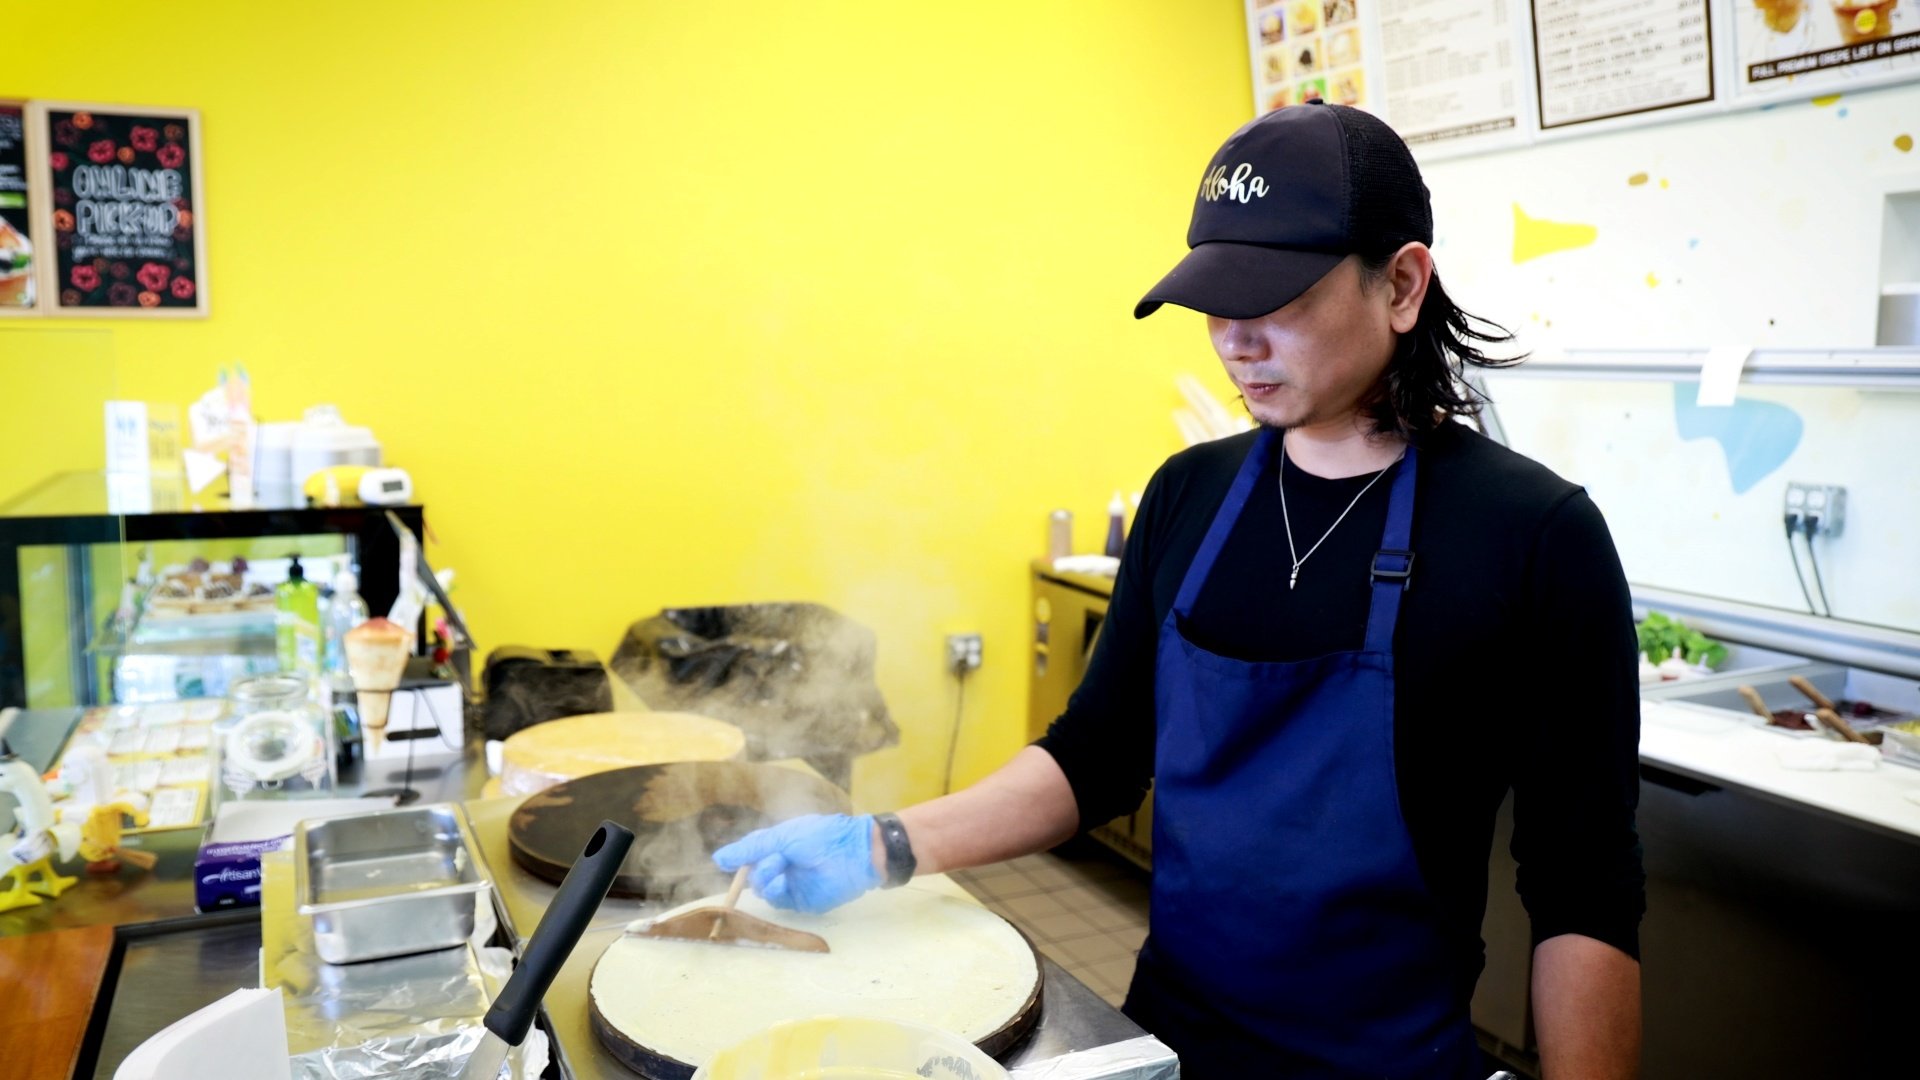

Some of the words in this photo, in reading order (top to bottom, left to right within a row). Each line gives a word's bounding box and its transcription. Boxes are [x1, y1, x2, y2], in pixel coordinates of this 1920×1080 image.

[1852, 43, 1874, 59] LIST
[73, 165, 182, 202] ONLINE
[1200, 162, 1270, 204] Aloha
